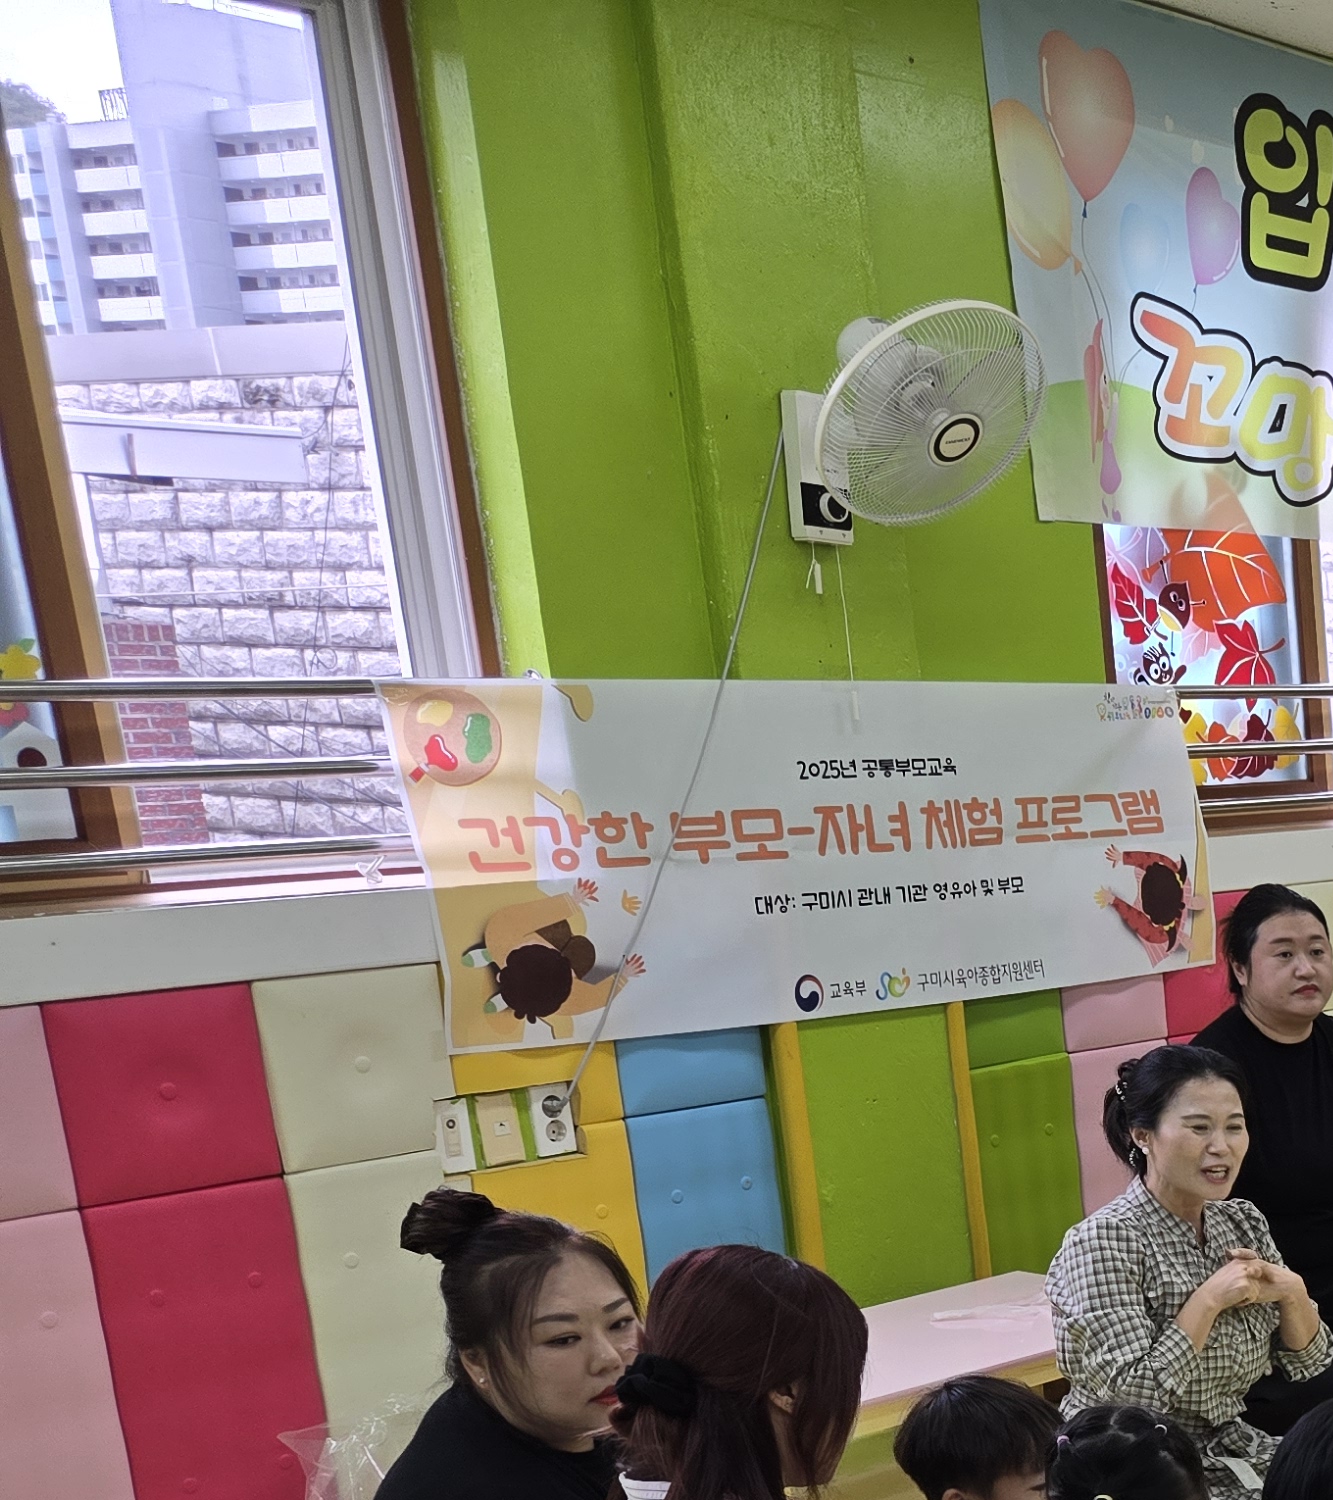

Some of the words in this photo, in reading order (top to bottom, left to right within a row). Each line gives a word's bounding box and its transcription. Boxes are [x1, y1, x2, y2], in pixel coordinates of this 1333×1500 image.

[796, 758, 858, 780] 2025년
[861, 757, 957, 779] 공통부모교육
[456, 809, 654, 874] 건강한
[671, 800, 912, 863] 부모-자녀
[919, 796, 1004, 850] 체험
[1014, 788, 1165, 844] 프로그램
[754, 893, 796, 915] 대상:
[801, 888, 853, 911] 구미시
[857, 886, 892, 907] 관내
[895, 884, 928, 903] 기관
[932, 880, 977, 901] 영유아
[980, 878, 994, 897] 및
[997, 876, 1025, 895] 부모
[829, 980, 867, 999] 교육부
[917, 959, 1046, 992] 구미시육아종합지원센터
